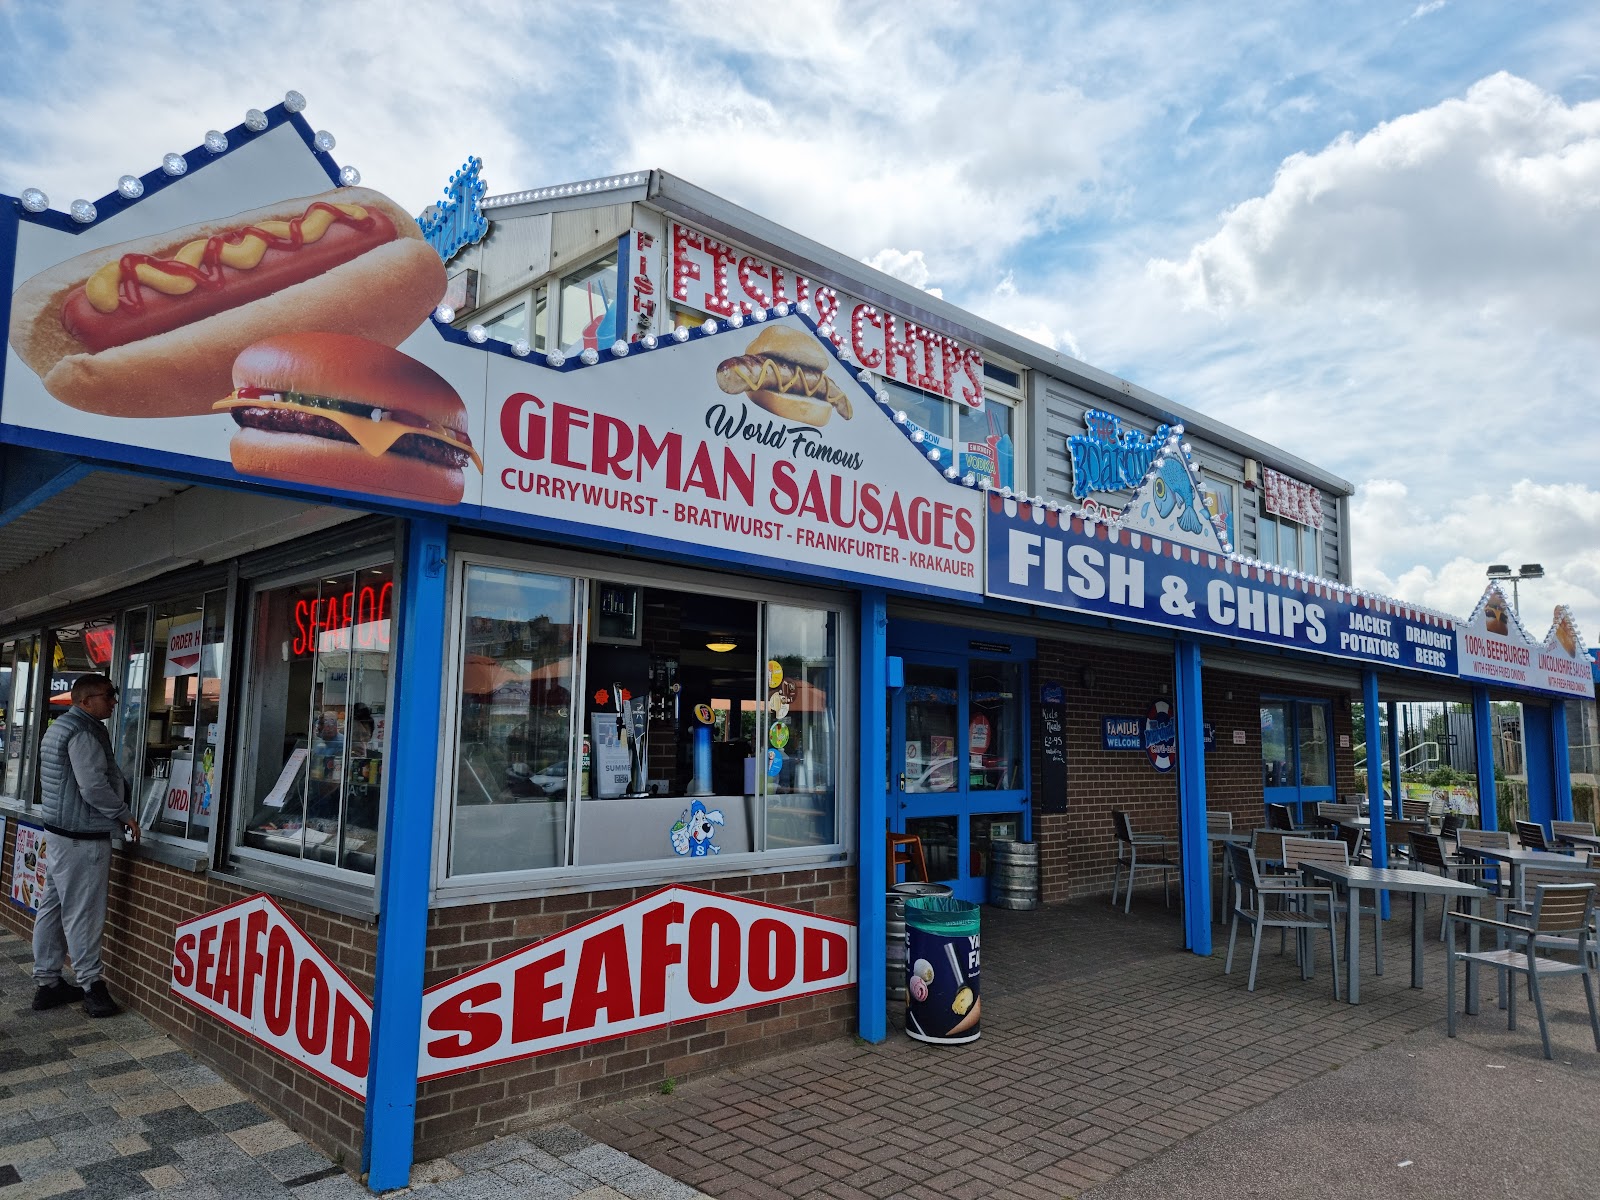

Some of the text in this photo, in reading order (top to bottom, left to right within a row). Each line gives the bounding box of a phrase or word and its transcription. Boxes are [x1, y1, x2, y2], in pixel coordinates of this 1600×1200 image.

[673, 224, 809, 318] FISH
[852, 304, 984, 407] CHIPS
[705, 404, 864, 472] World Famous
[500, 392, 975, 554] GERMAN SAUSAGES
[965, 453, 997, 475] VODKA
[500, 468, 656, 518] CURRYWURST
[674, 505, 784, 541] BRATWURST
[796, 527, 899, 565] FRANKFURTER
[909, 552, 975, 578] KRAKAUER
[1008, 528, 1327, 644] FISH & CHIPS
[1348, 611, 1392, 637] JACKET
[170, 632, 193, 652] ORDER
[1340, 631, 1400, 660] POTATOES
[1405, 625, 1452, 651] DRAUGHT
[1464, 634, 1486, 658] 100%
[1486, 639, 1531, 667] BEEFBURGER
[1415, 646, 1446, 668] BEERS
[1473, 661, 1485, 673] WITH
[1485, 663, 1498, 676] FRESH
[1498, 666, 1511, 679] FRIED
[1538, 653, 1573, 676] LINCOLNSHIRE
[51, 678, 71, 691] ish
[1107, 721, 1140, 736] FAMILIES
[1107, 738, 1141, 747] WELCOME
[427, 901, 848, 1059] SEAFOOD
[173, 909, 370, 1079] SEAFOOD
